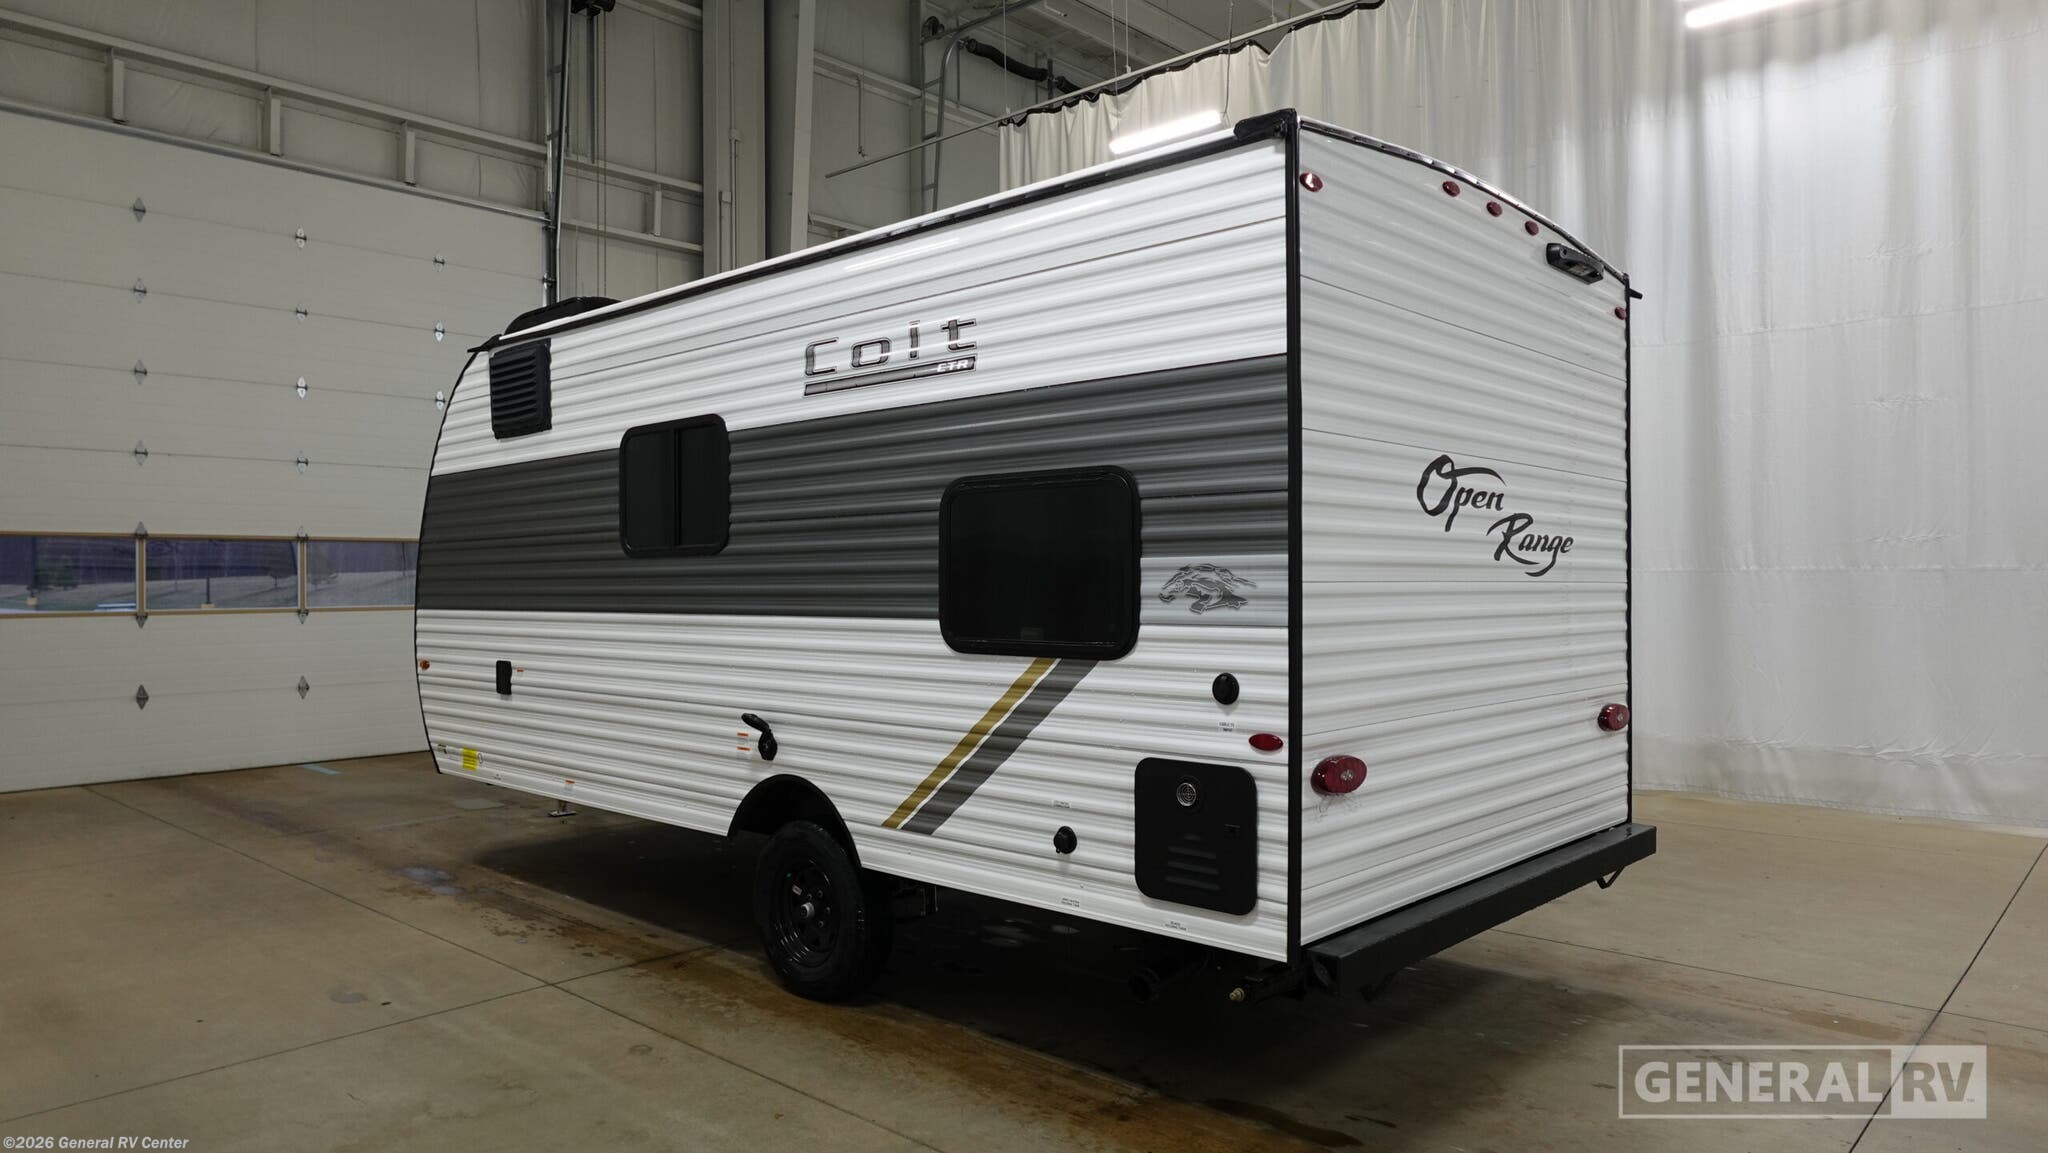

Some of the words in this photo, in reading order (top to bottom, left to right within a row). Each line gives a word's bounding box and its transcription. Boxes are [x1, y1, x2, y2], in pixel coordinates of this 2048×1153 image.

[805, 318, 977, 377] Colt
[936, 359, 969, 373] ETR
[1416, 454, 1507, 533] Open
[1486, 512, 1575, 578] Range
